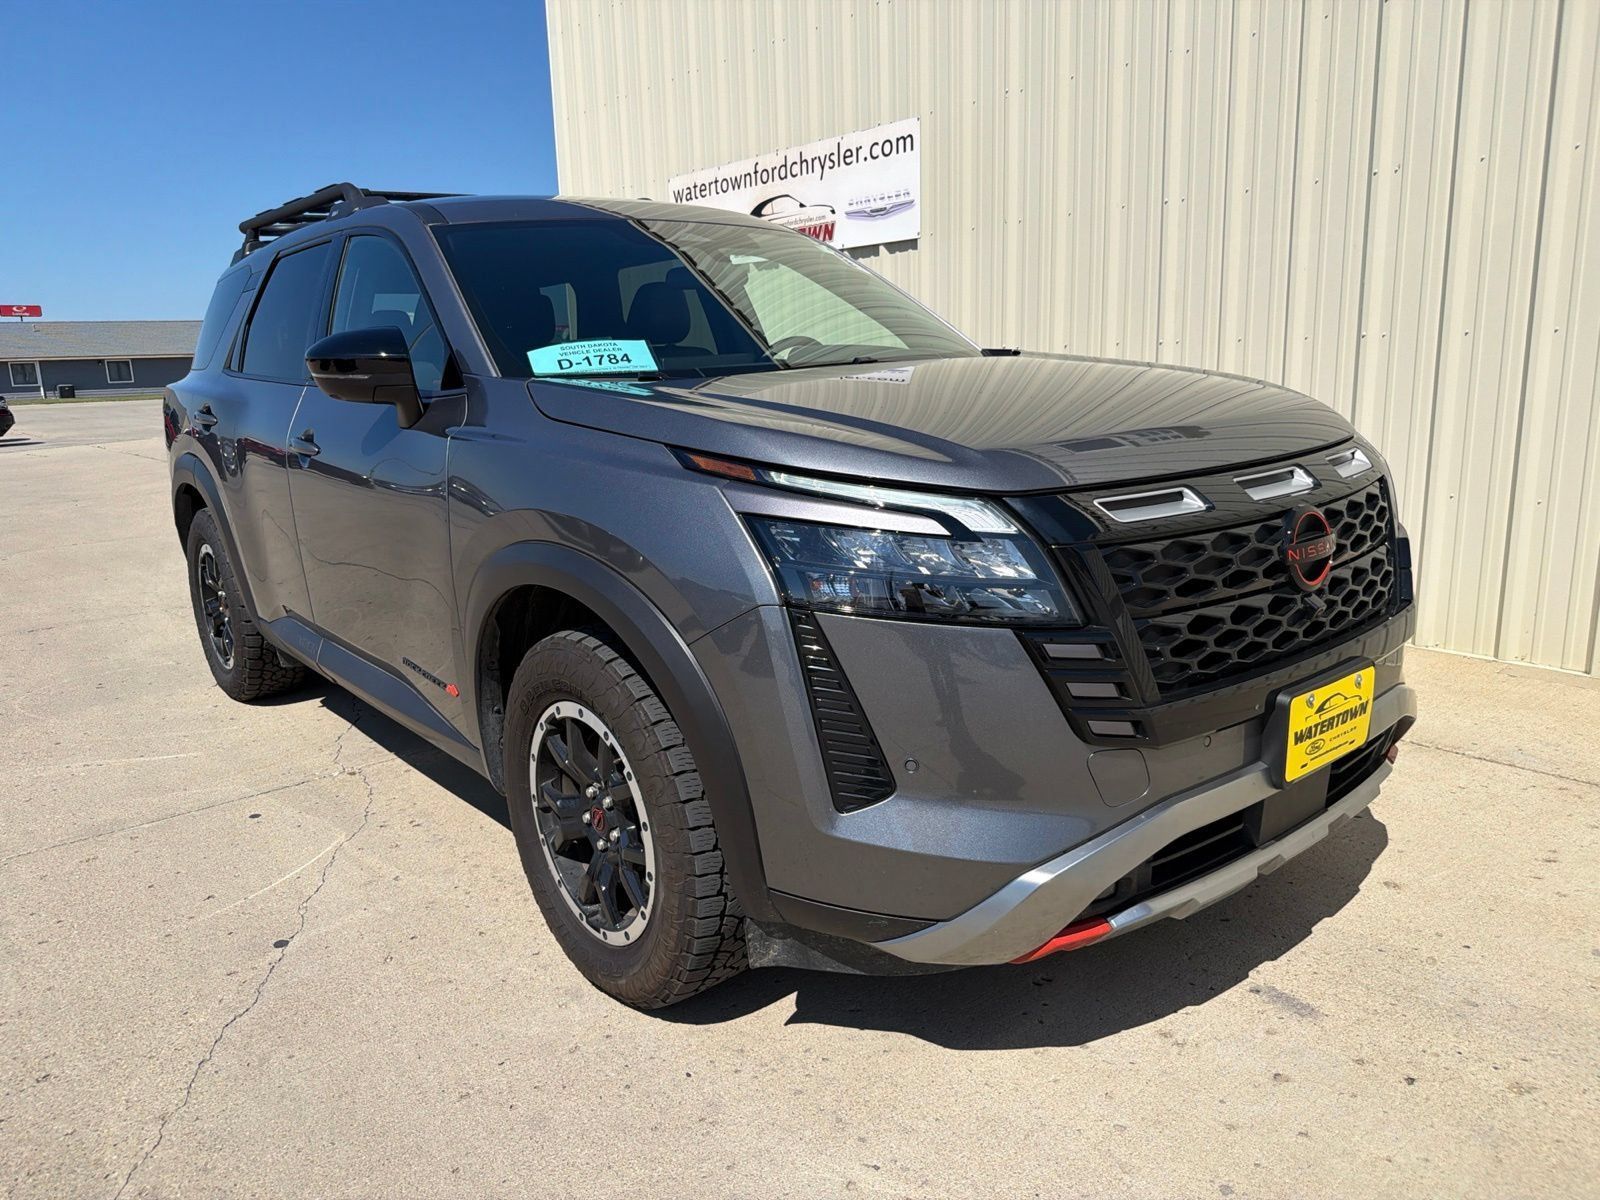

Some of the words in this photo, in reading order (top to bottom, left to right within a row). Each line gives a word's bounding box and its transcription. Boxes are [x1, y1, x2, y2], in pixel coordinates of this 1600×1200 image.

[672, 133, 914, 205] watertownfordchrysler.com
[559, 349, 592, 357] VEHICLE
[560, 343, 586, 351] SOUTH
[588, 341, 619, 349] DAKOTA
[557, 352, 633, 371] D-1784
[1293, 699, 1369, 747] WATERTOWN
